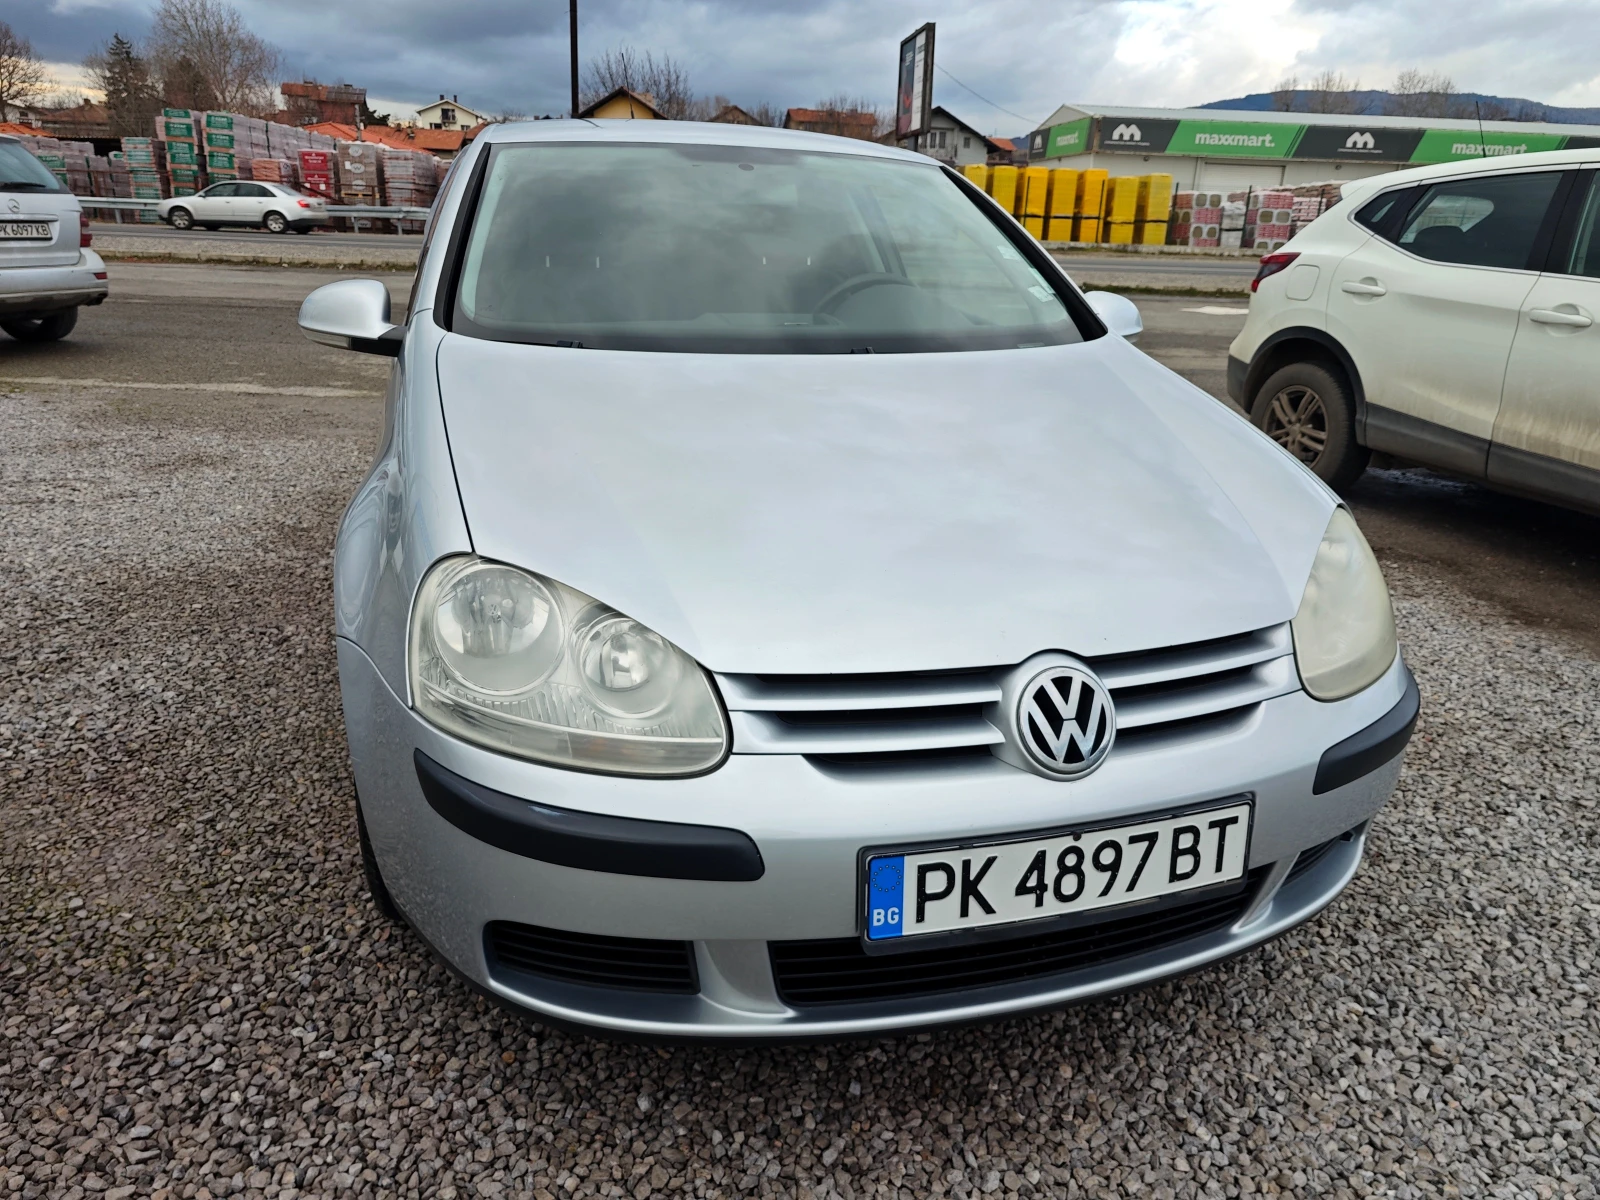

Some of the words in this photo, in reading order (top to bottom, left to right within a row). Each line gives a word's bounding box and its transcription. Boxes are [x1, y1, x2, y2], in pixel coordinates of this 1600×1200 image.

[915, 855, 997, 924] PK
[1014, 831, 1159, 909] 4897
[1168, 815, 1240, 884] BT
[872, 907, 900, 927] BG
